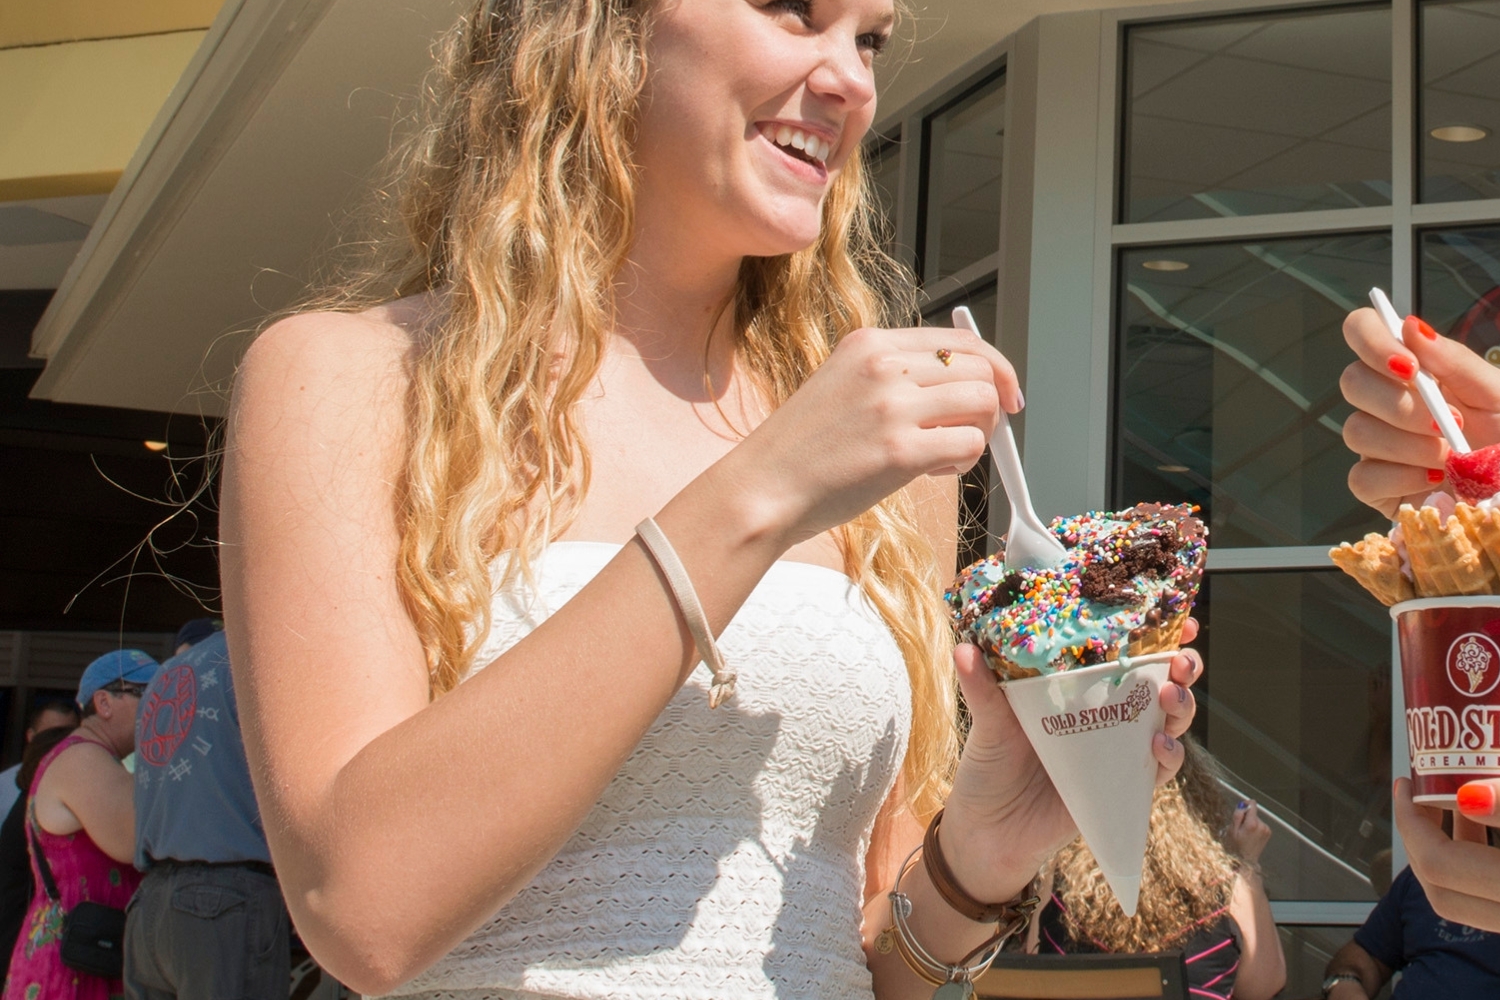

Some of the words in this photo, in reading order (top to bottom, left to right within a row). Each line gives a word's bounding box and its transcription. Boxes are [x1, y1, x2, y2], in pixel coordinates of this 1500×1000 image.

[1041, 712, 1077, 735] COLD
[1079, 702, 1131, 726] STONE
[1058, 721, 1116, 736] CREAMERY
